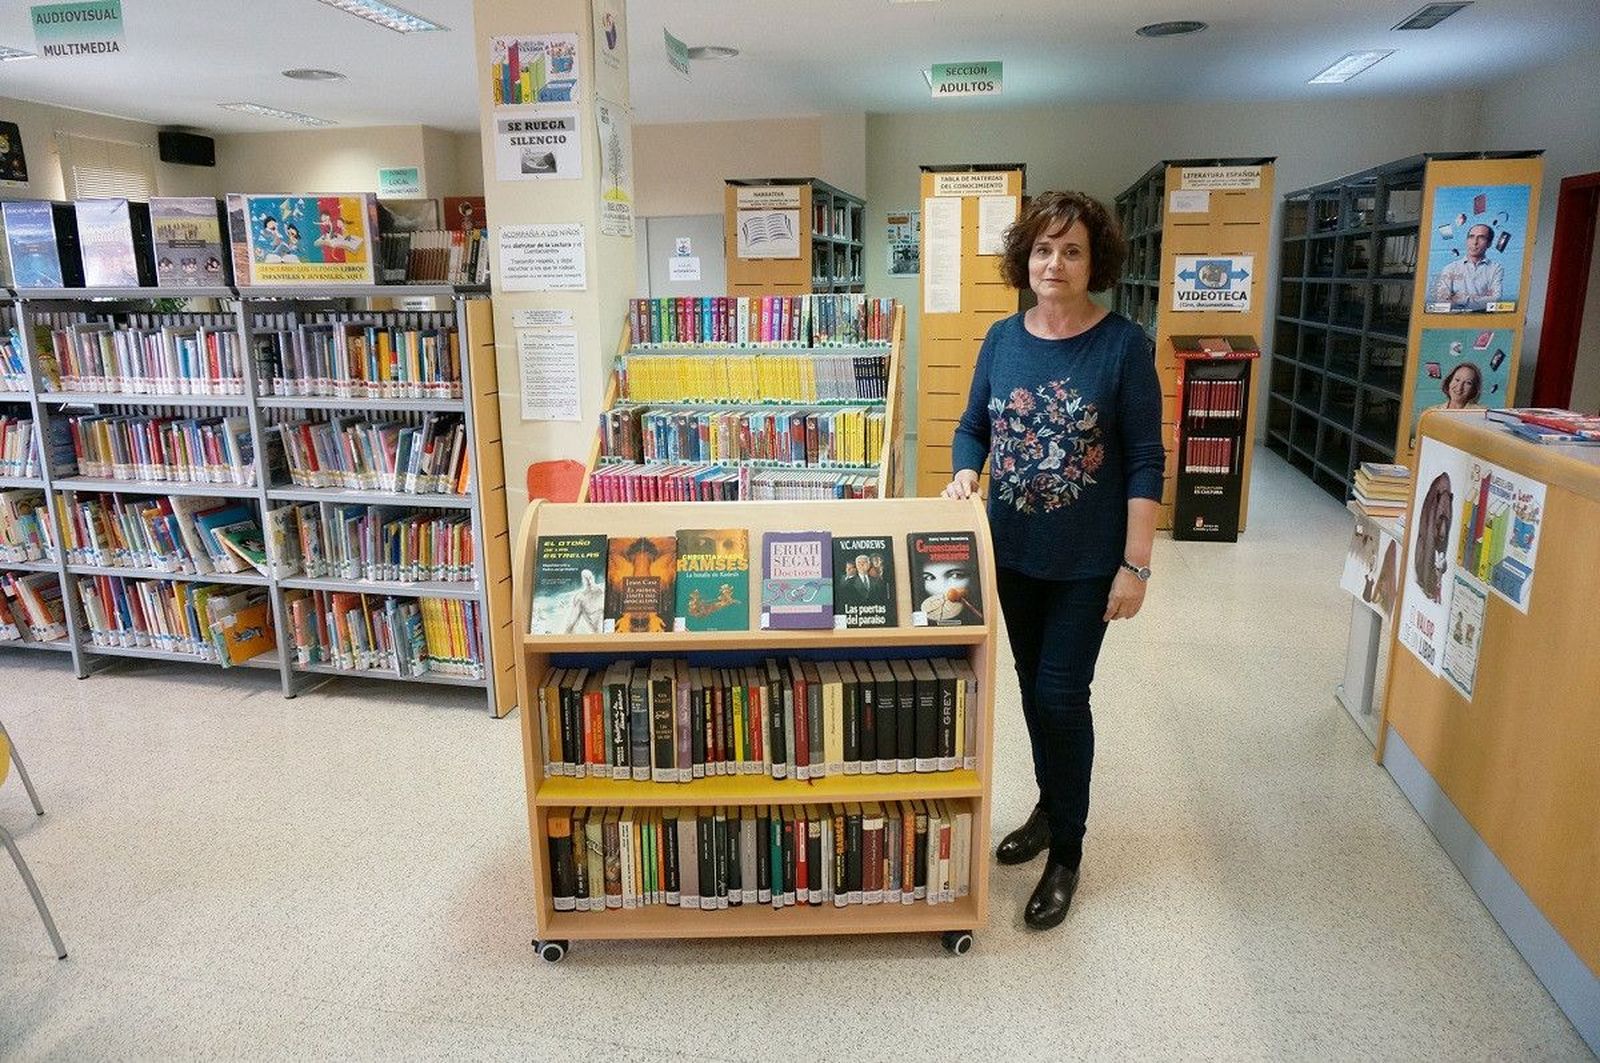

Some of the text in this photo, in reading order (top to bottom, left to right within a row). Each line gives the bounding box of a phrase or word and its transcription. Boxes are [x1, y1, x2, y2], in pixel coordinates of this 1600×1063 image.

[36, 8, 118, 24] AUDIOVISUAL
[44, 41, 119, 56] MULTIMEDIA
[946, 65, 987, 76] SECCIÓN
[940, 81, 994, 93] ADULTOS
[508, 120, 566, 131] SE RUEGA
[510, 135, 567, 146] SILENCIO
[1226, 170, 1260, 178] ESPAÑOLA
[1177, 290, 1248, 301] VIDEOTECA
[774, 544, 819, 555] ERICH
[774, 556, 819, 567] SEGAL
[774, 568, 820, 576] Doctores
[845, 604, 886, 615] Las puertas
[847, 614, 886, 627] del paraíso
[943, 689, 952, 725] GREY
